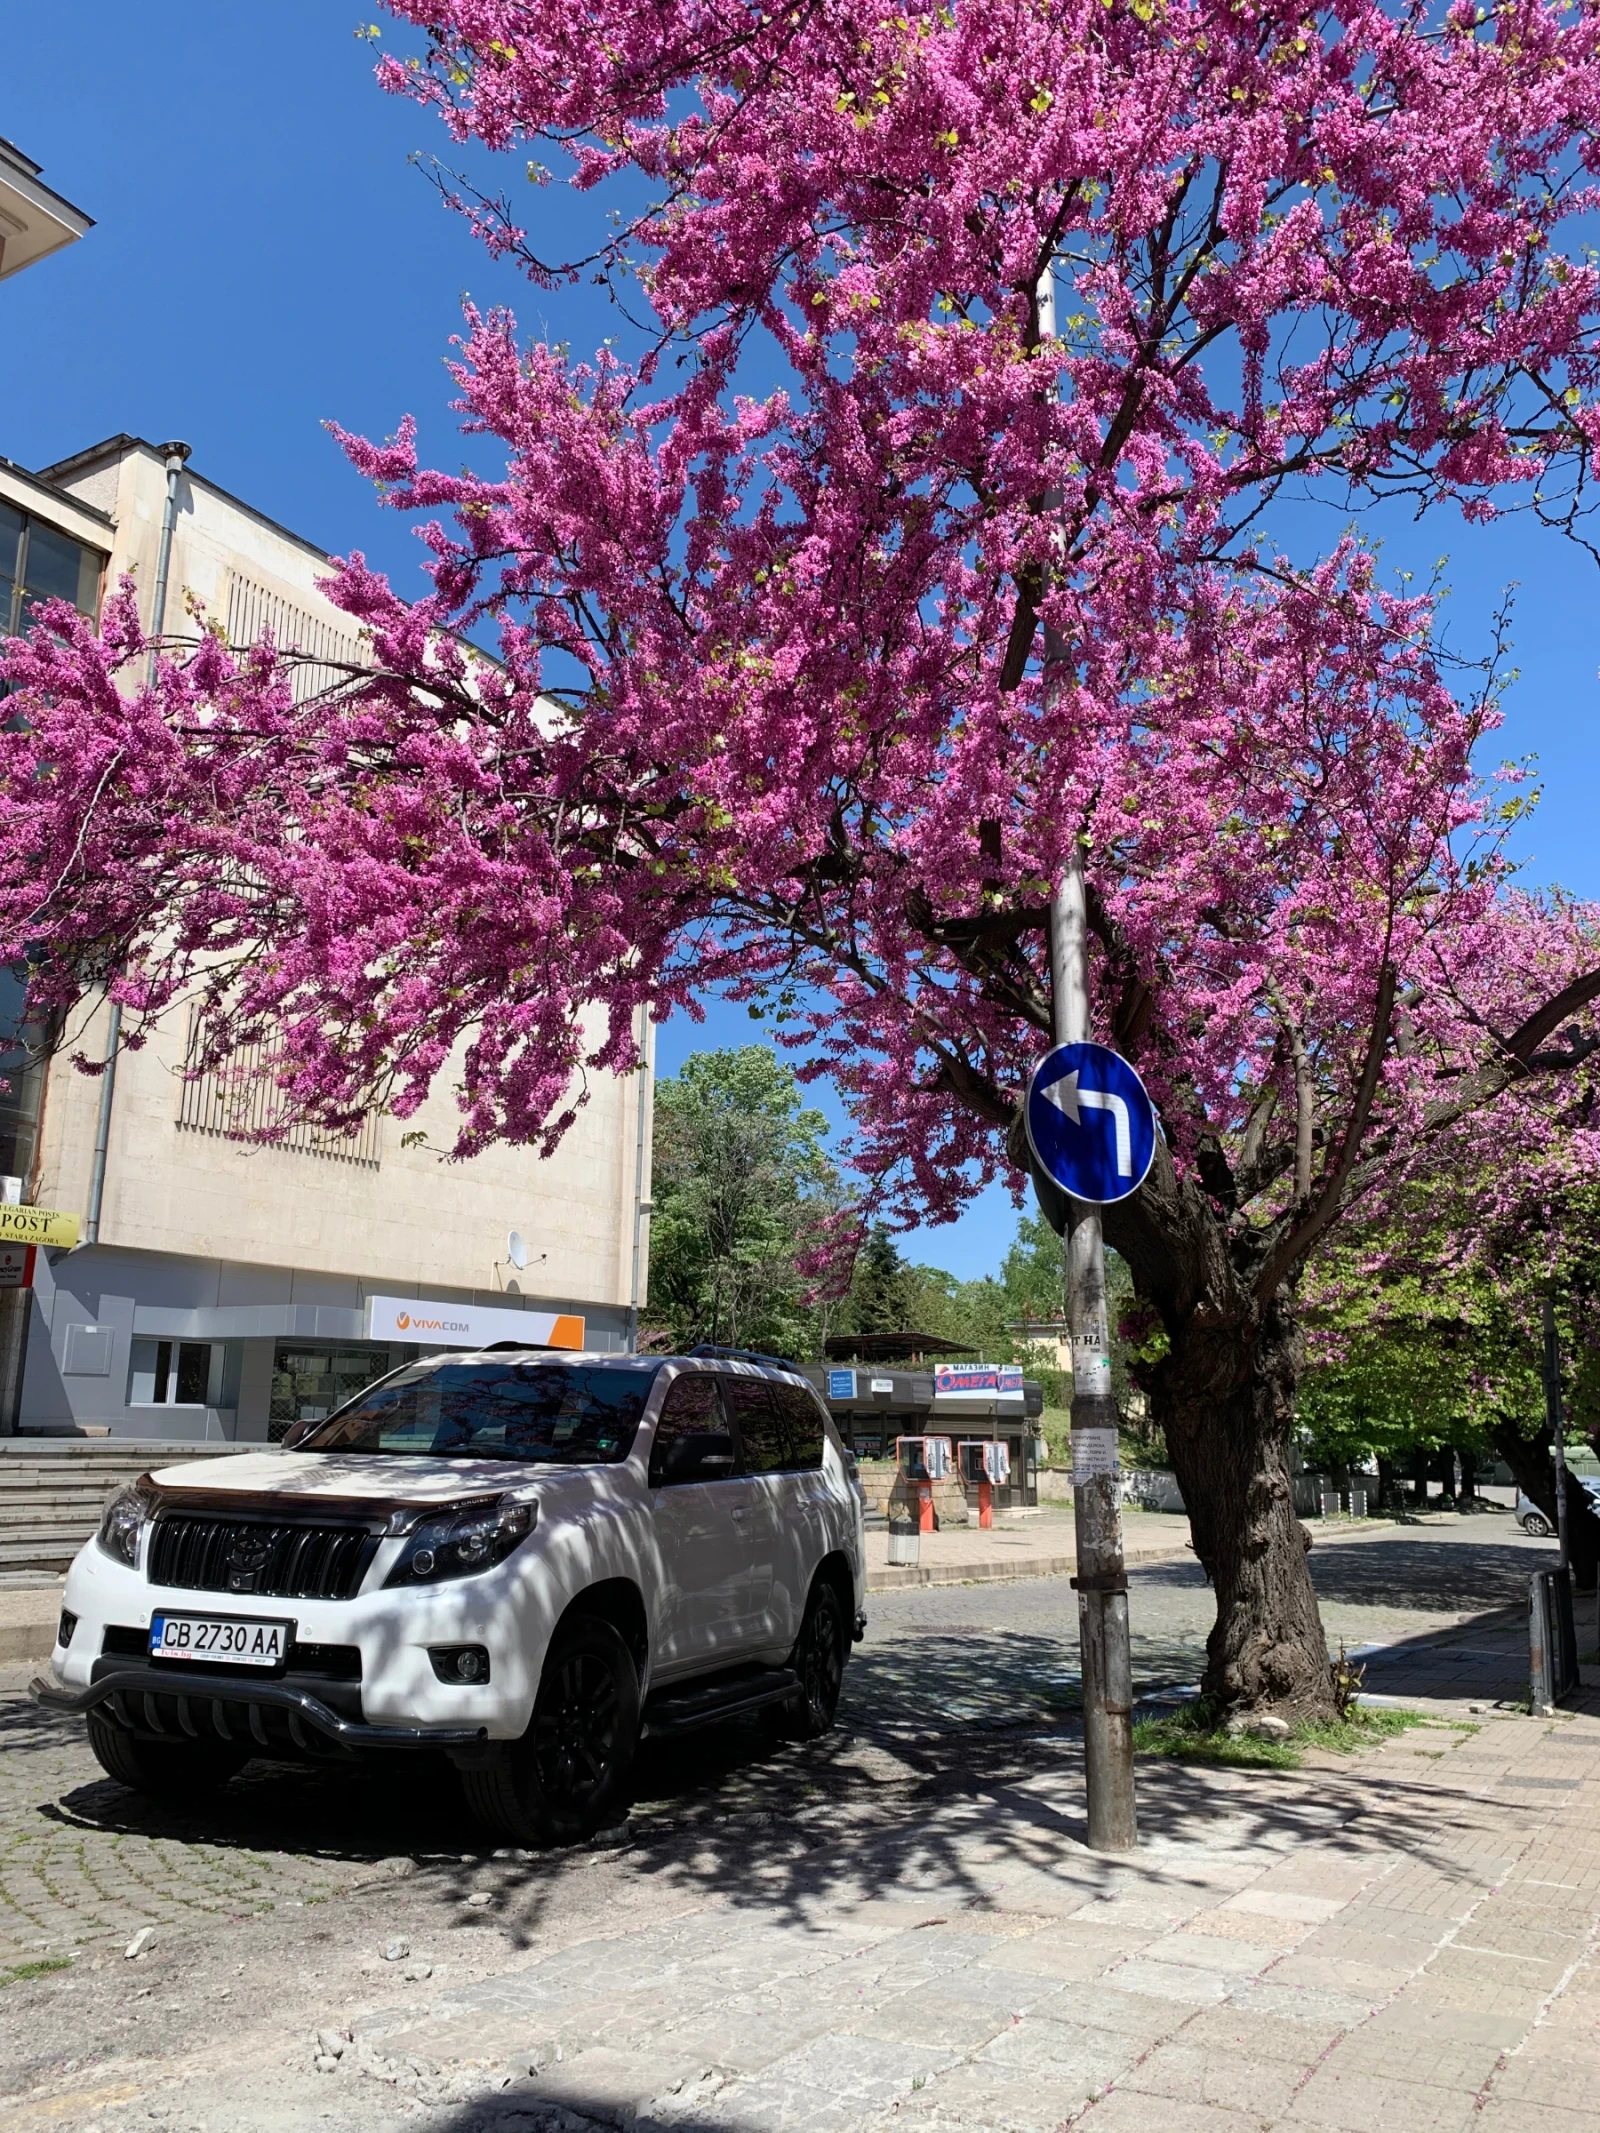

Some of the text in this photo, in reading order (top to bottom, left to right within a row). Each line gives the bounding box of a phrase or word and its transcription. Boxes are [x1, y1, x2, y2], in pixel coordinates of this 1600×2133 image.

[39, 1209, 60, 1218] POSTS
[1, 1213, 52, 1232] POST
[5, 1232, 28, 1241] STARA
[29, 1235, 59, 1245] ZAGORA
[412, 1318, 469, 1332] VIVACOM
[953, 1364, 989, 1376] МАГАЗИН
[152, 1636, 161, 1645] BG
[164, 1622, 279, 1656] CB 2730 AA
